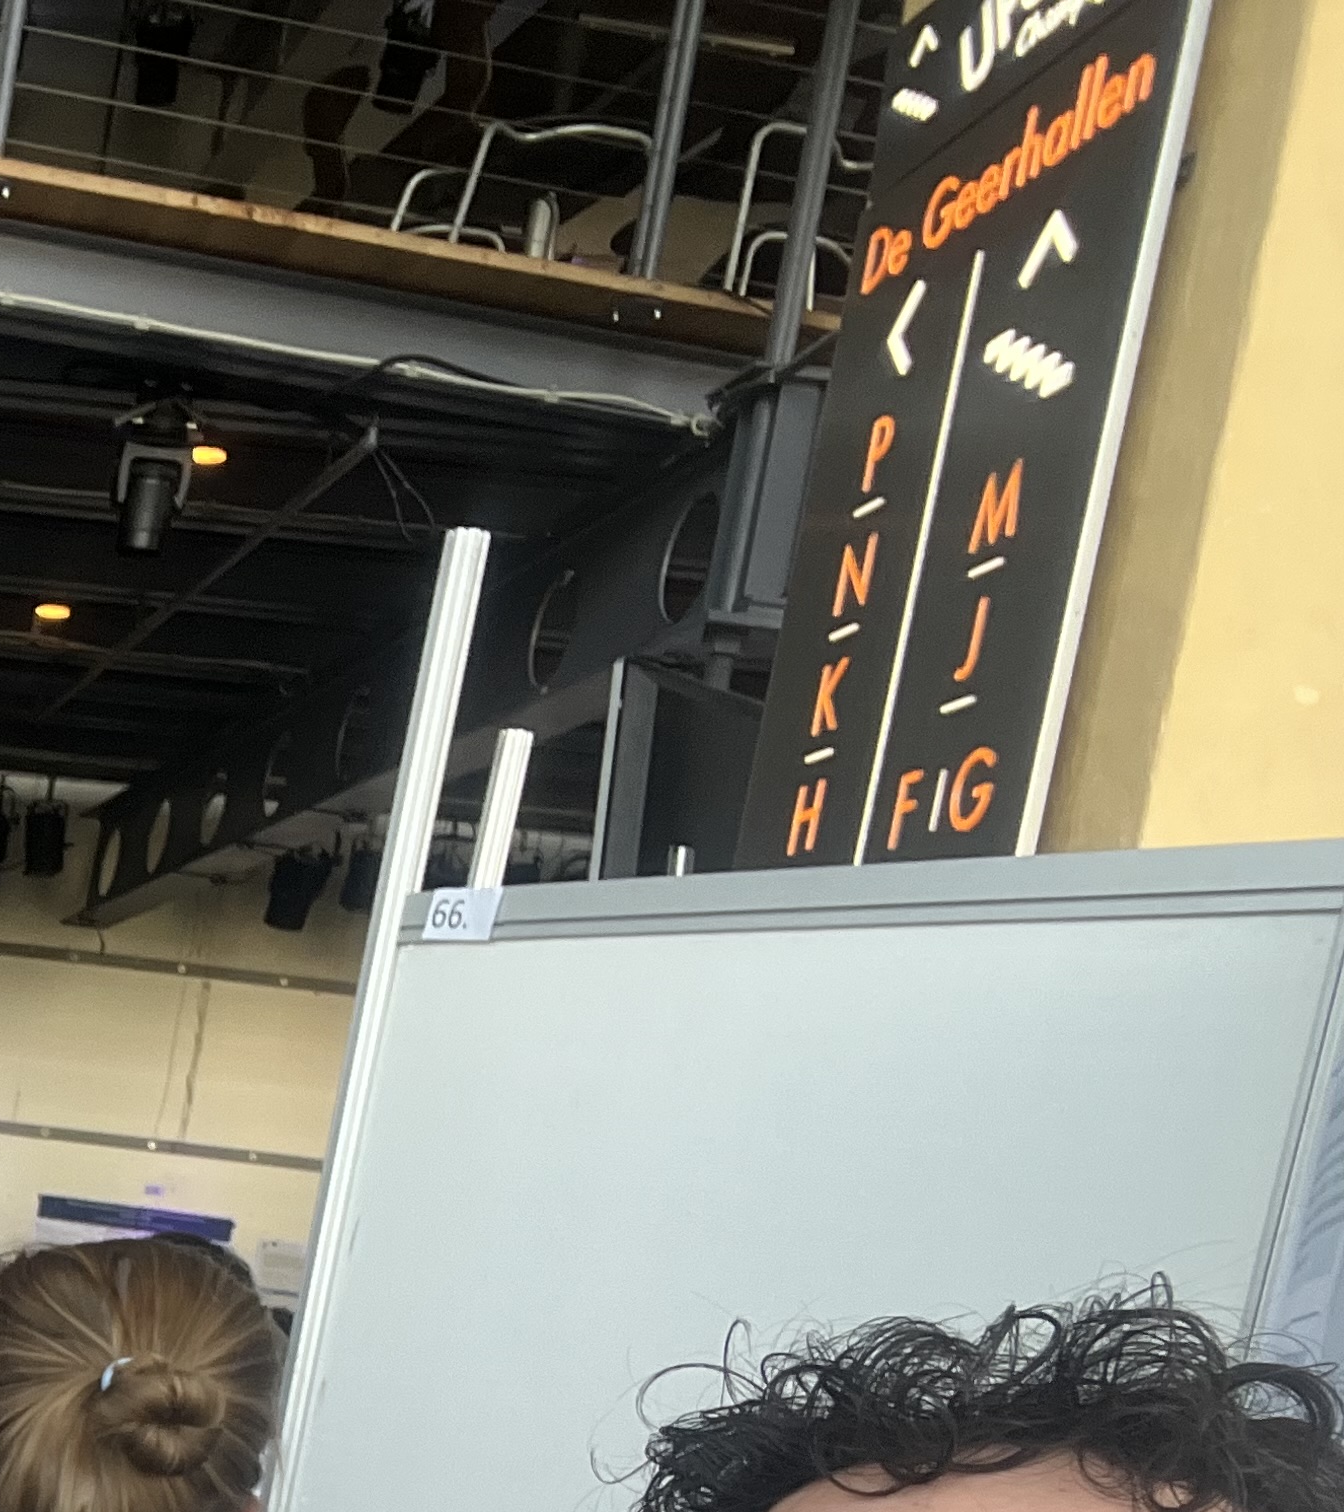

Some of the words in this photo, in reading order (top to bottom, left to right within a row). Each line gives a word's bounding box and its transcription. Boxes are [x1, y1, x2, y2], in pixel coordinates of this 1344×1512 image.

[861, 227, 912, 295] De
[922, 52, 1157, 249] Geerhallen
[862, 415, 895, 492] P
[969, 458, 1024, 556] M
[833, 532, 878, 616] N
[955, 597, 991, 682] J
[811, 658, 851, 737] K
[787, 779, 827, 857] H
